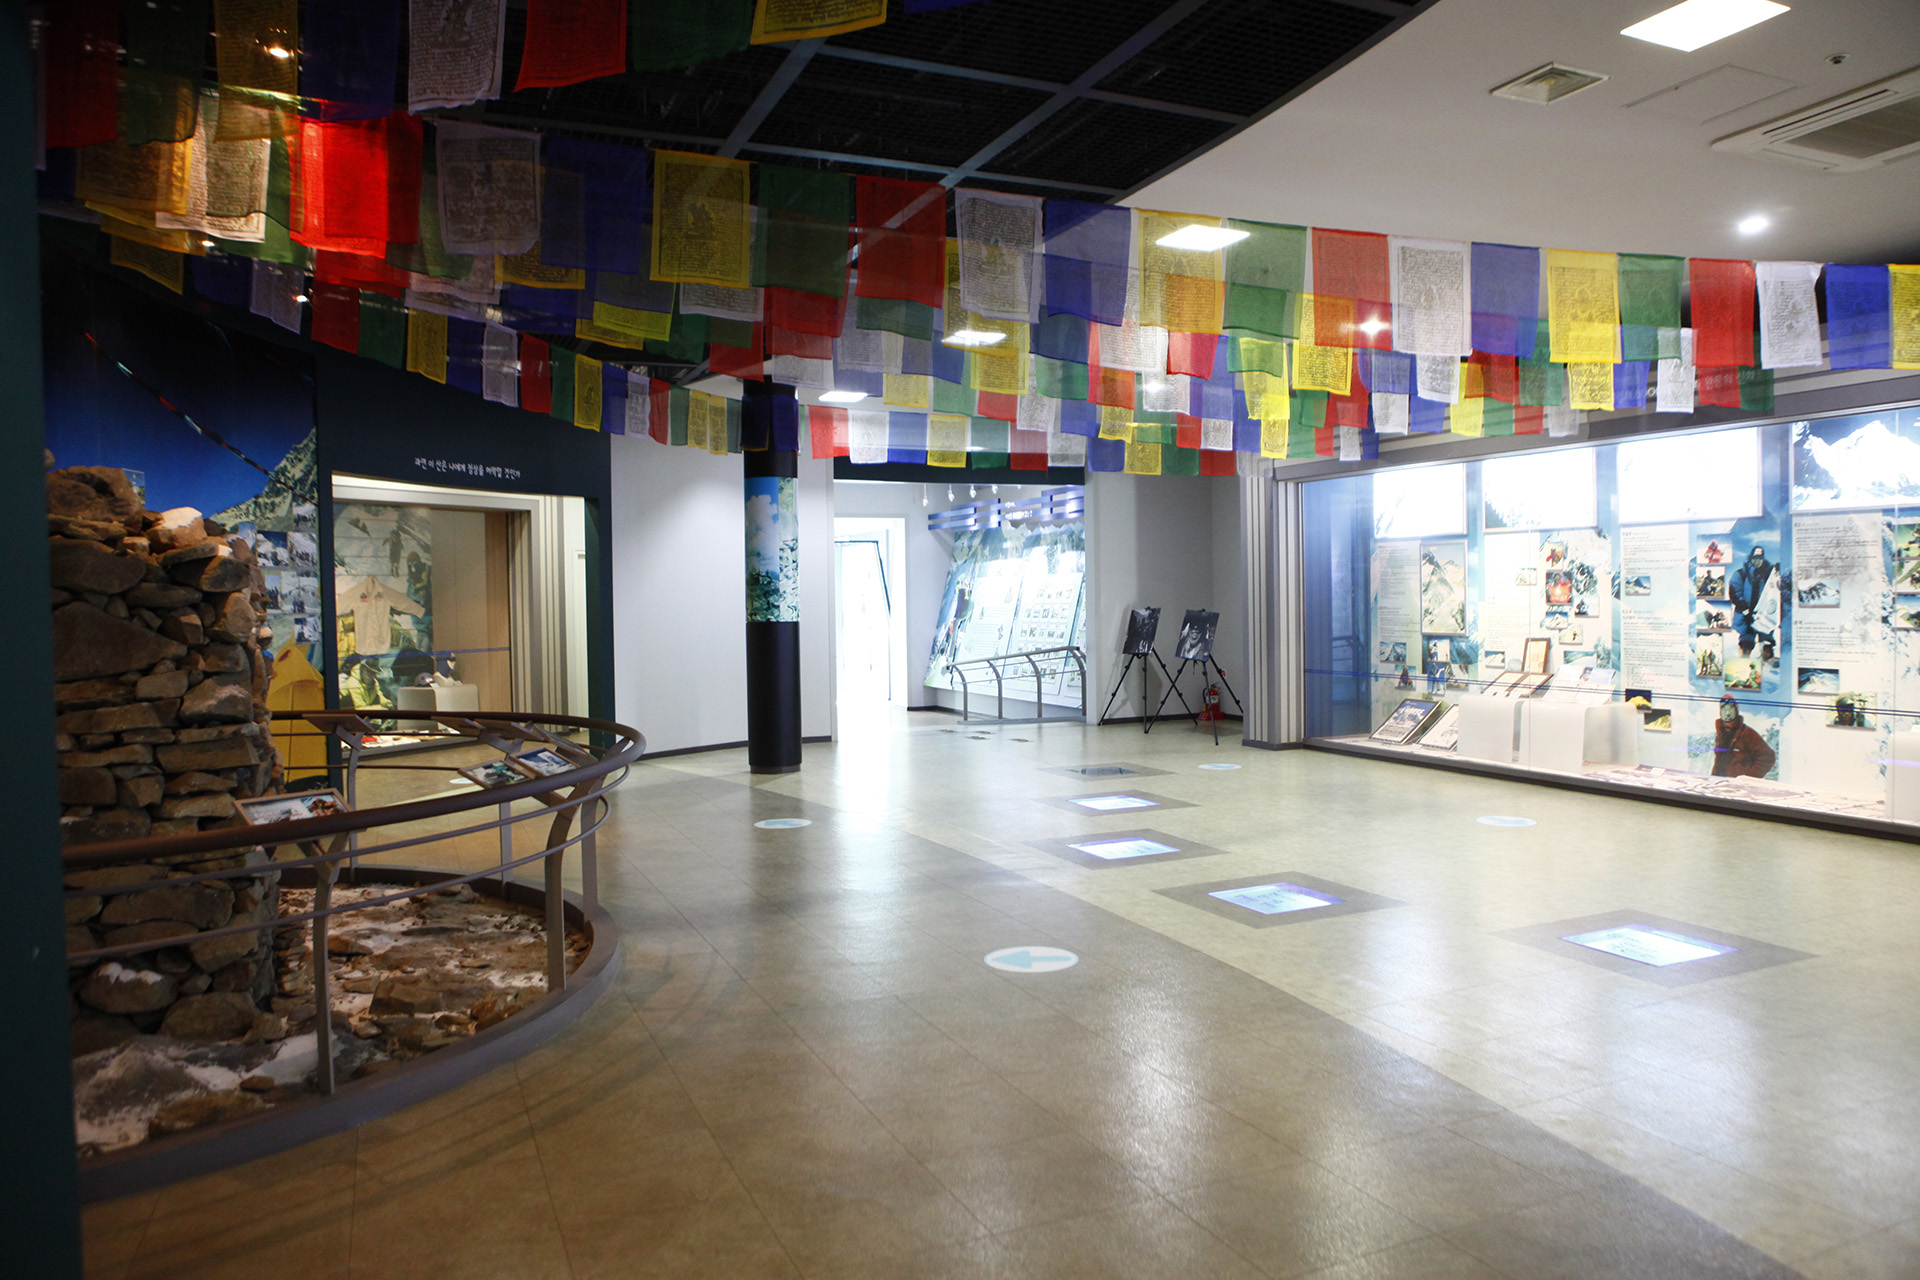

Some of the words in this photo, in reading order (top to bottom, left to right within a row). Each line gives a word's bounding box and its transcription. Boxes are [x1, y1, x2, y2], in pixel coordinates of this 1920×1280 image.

[414, 457, 427, 470] 과연
[428, 460, 434, 468] 이
[435, 459, 448, 472] 산은
[448, 462, 466, 472] 나에게
[467, 463, 484, 476] 정상을
[485, 466, 502, 478] 허락할
[503, 467, 521, 480] 것인가
